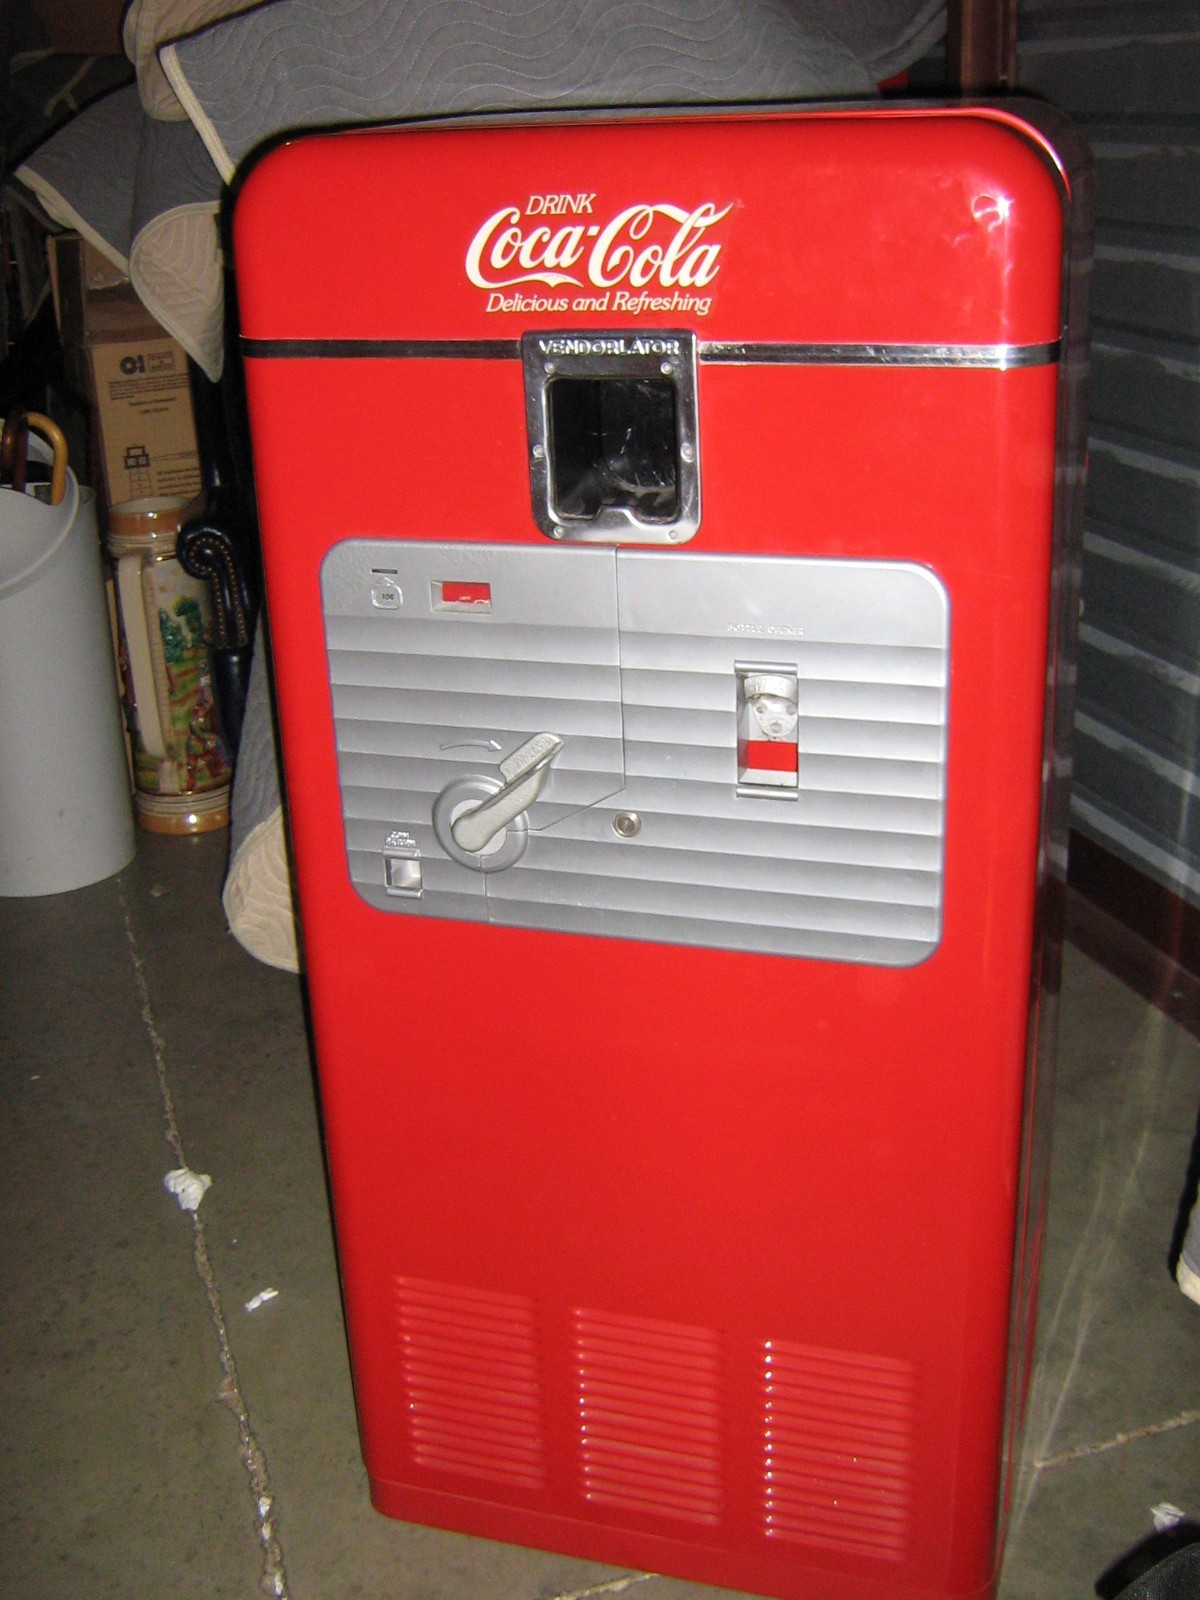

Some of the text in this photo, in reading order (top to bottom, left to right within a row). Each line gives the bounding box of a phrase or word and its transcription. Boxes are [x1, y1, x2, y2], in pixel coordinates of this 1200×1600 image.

[525, 193, 597, 215] DRINK
[465, 203, 734, 289] Coca-Cola
[486, 291, 713, 316] Delicious and Refreshing
[538, 338, 681, 356] VENDORLATOR
